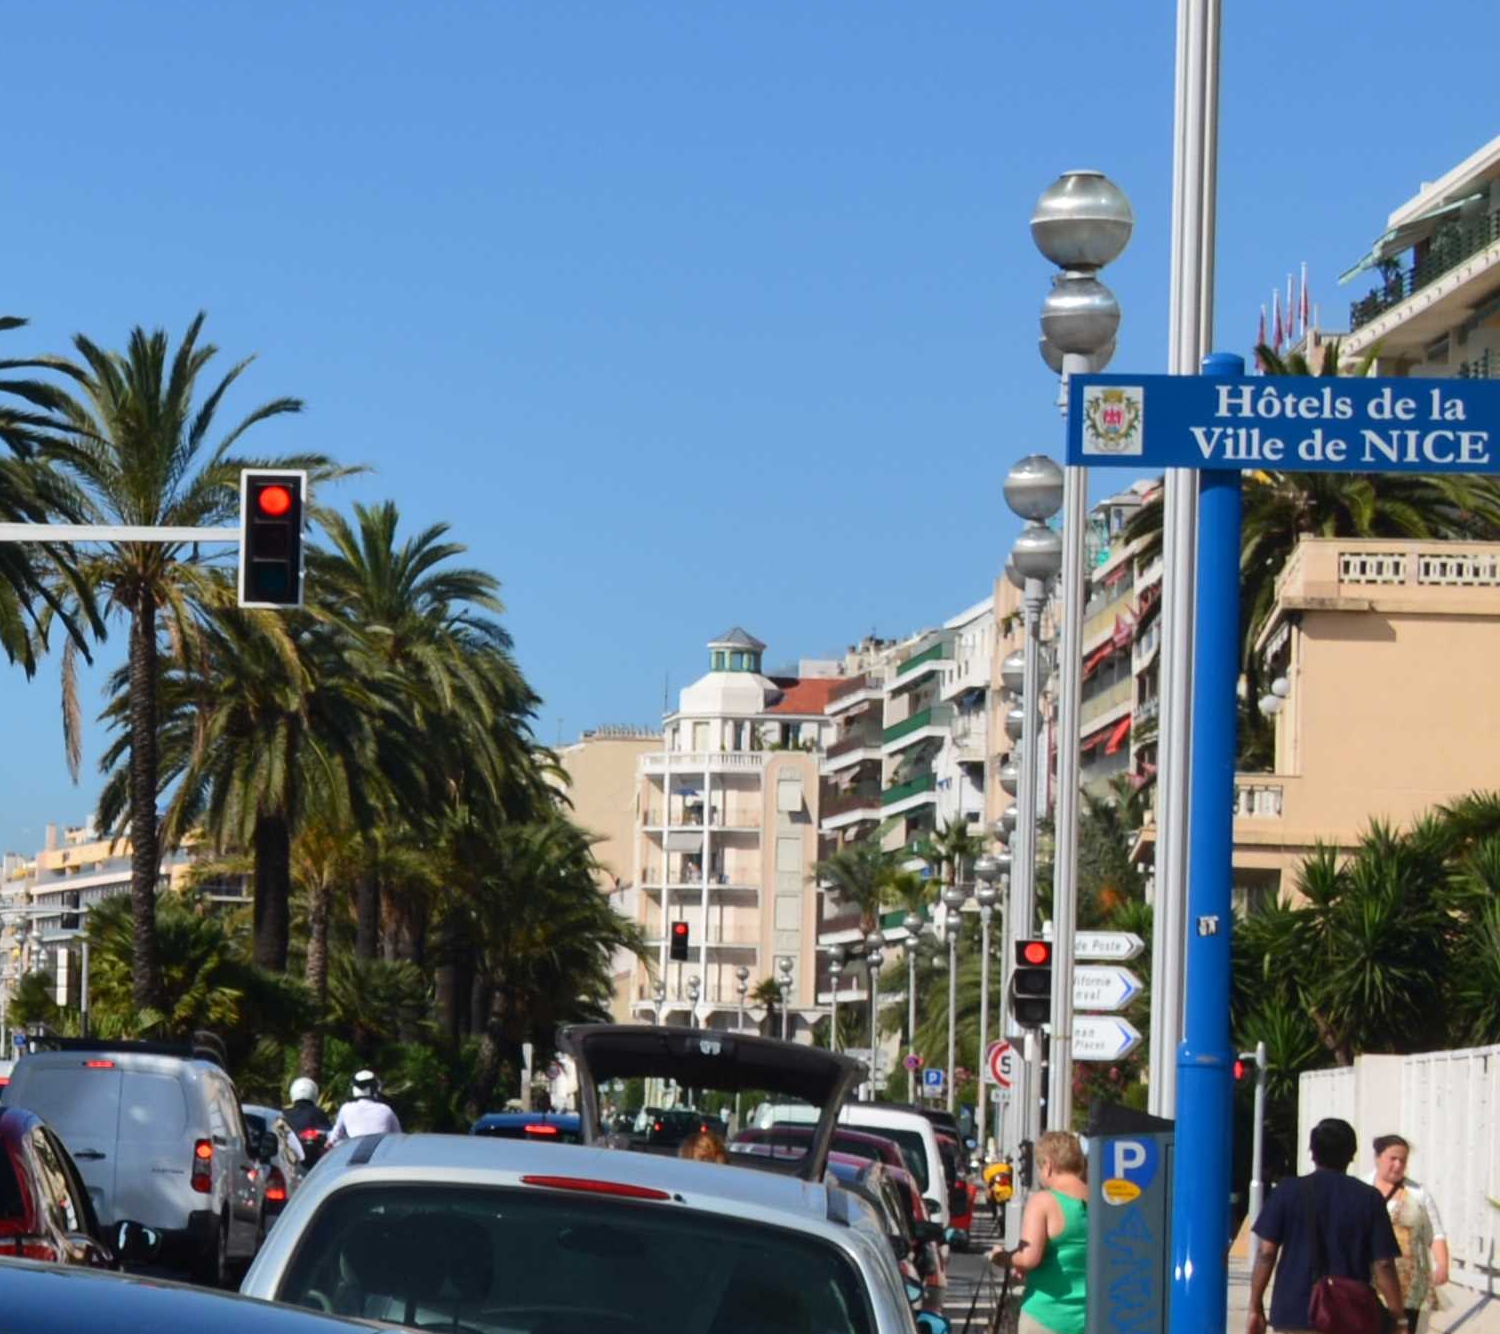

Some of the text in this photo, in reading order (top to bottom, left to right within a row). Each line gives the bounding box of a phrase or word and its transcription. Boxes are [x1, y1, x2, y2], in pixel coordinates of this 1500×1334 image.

[1216, 385, 1466, 421] Hôtels de la
[1190, 427, 1489, 464] Ville de NICE
[1076, 988, 1102, 1001] nval
[1114, 1140, 1147, 1180] P
